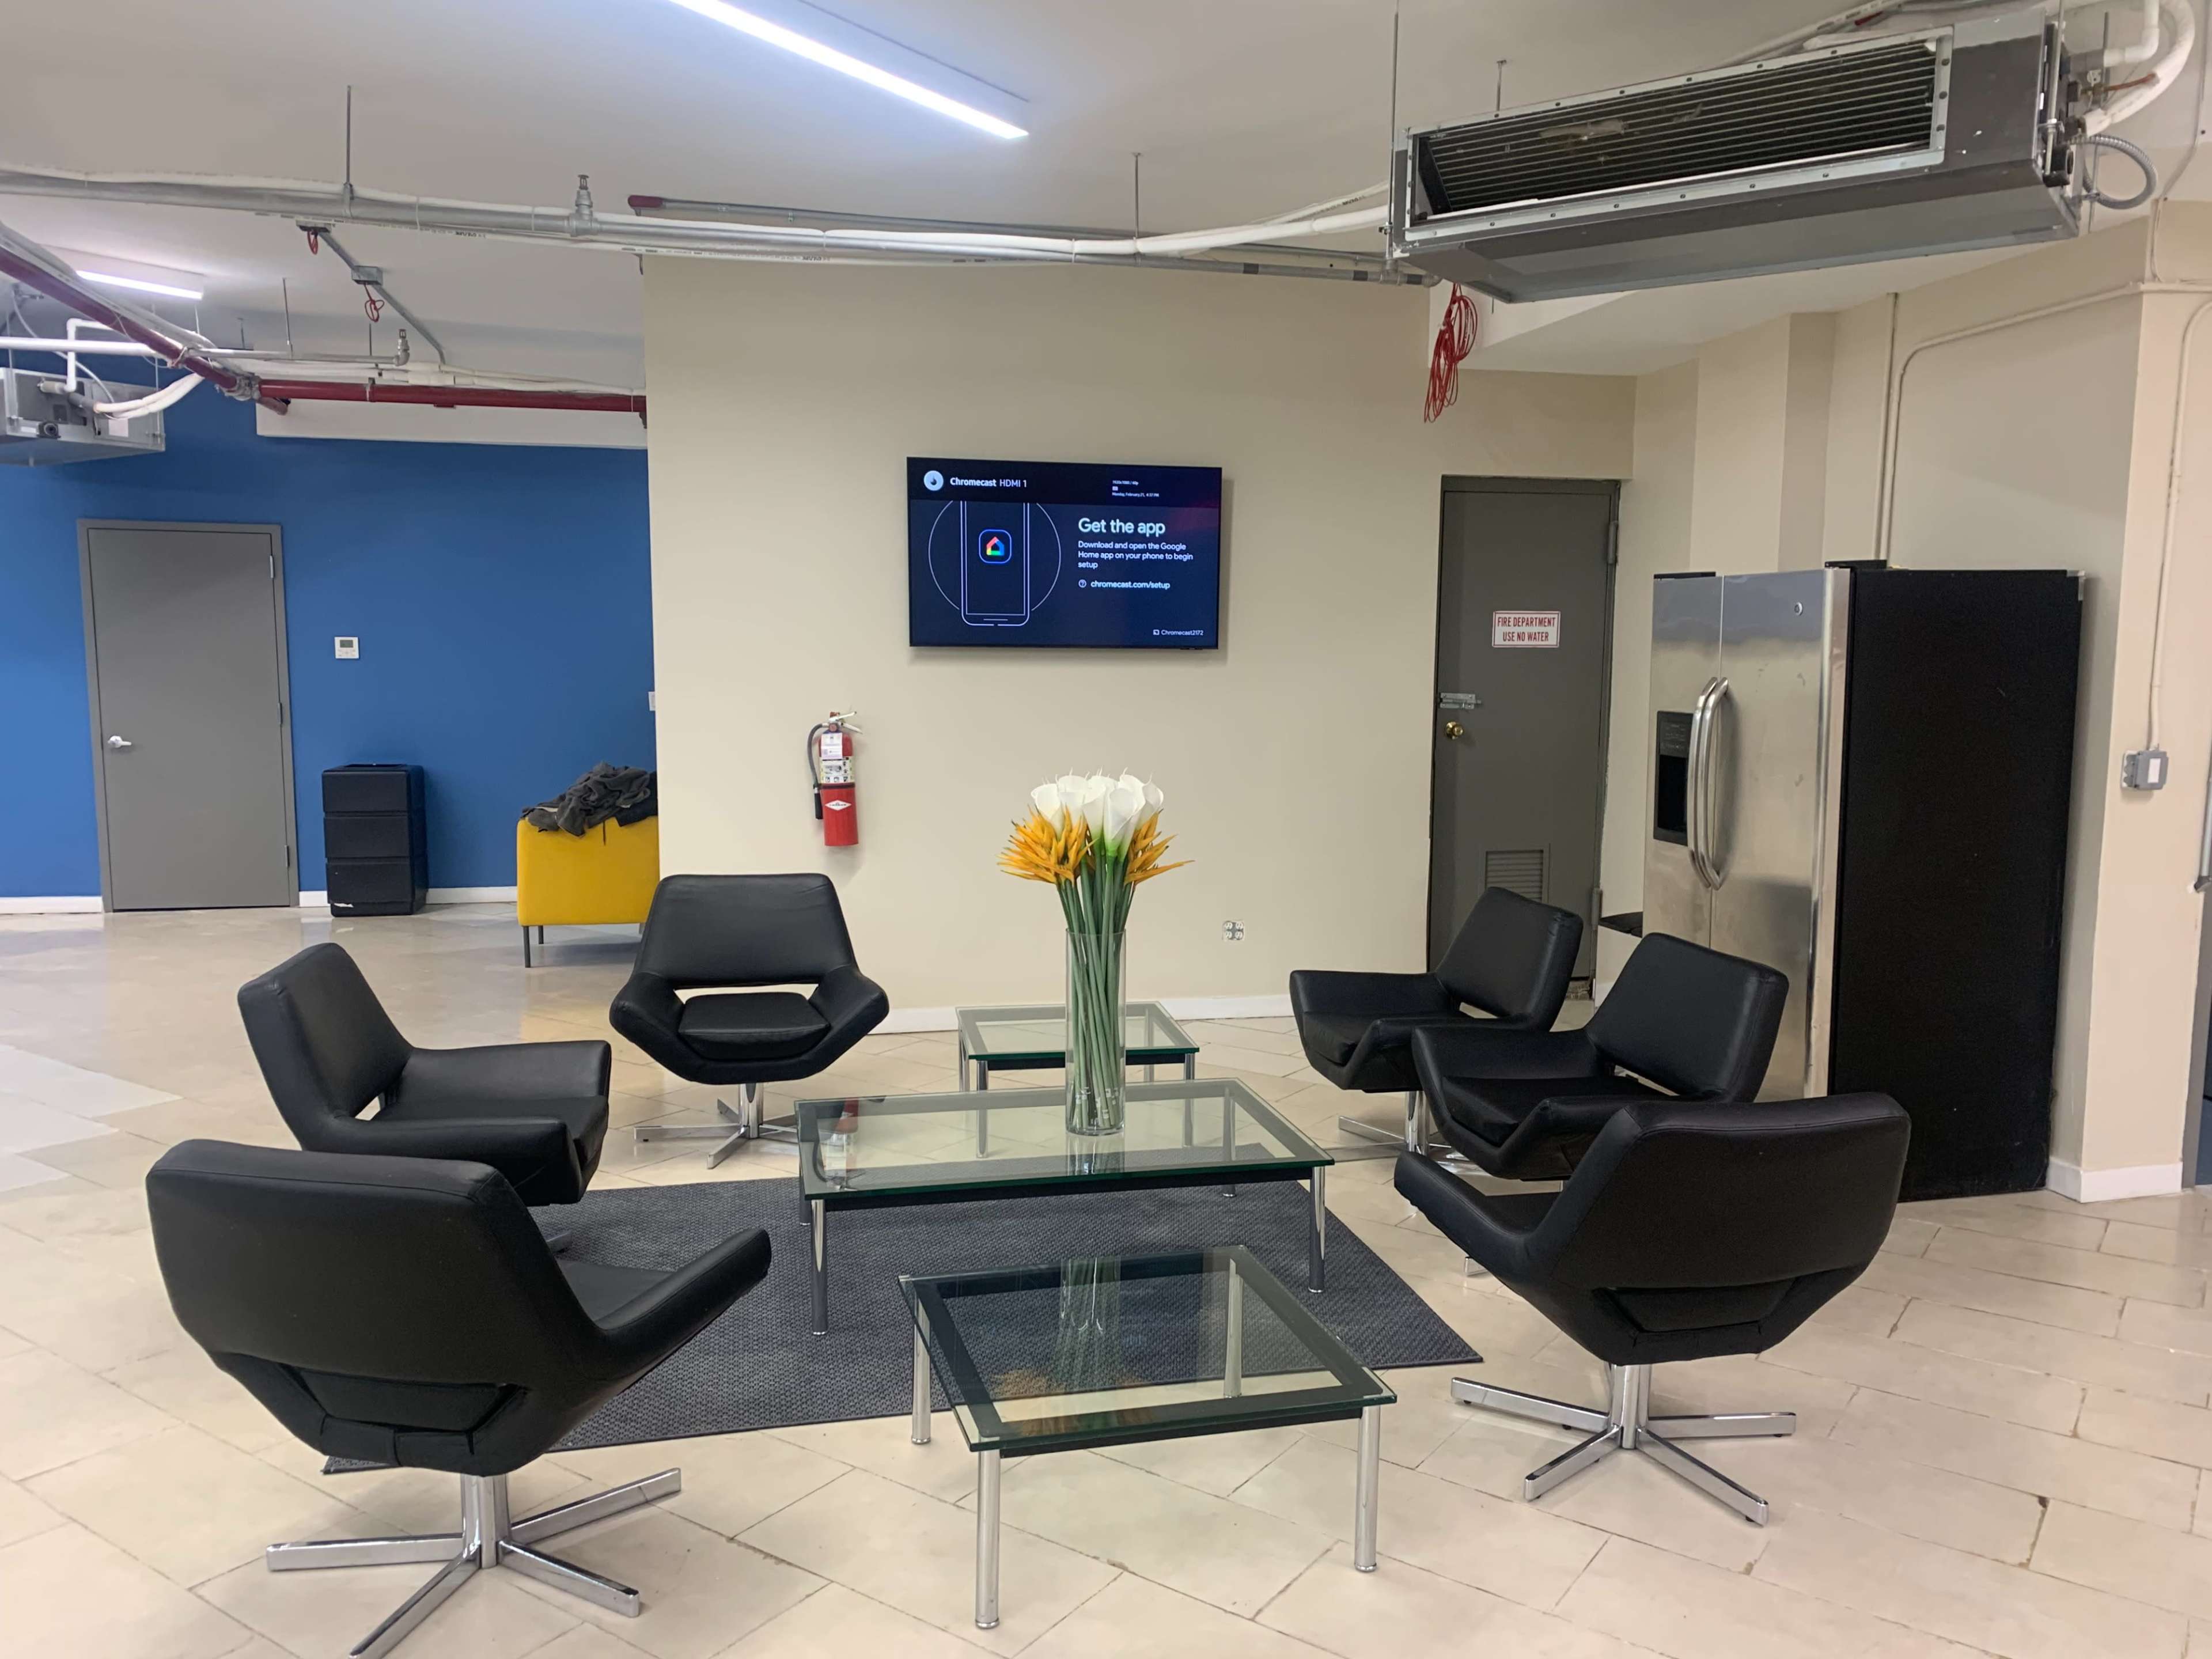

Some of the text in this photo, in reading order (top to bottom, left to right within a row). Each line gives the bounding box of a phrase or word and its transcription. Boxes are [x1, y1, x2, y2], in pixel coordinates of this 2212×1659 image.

[950, 478, 1027, 487] Chromecast HDMI 1
[1078, 518, 1165, 537] Get the app
[1160, 543, 1187, 551] Google
[1142, 552, 1164, 560] phone
[1173, 552, 1193, 561] begin
[1090, 580, 1171, 590] chromecast.com/setup
[1498, 617, 1556, 627] FIRE DEPARTMENT
[1503, 631, 1549, 641] USE NO WATER
